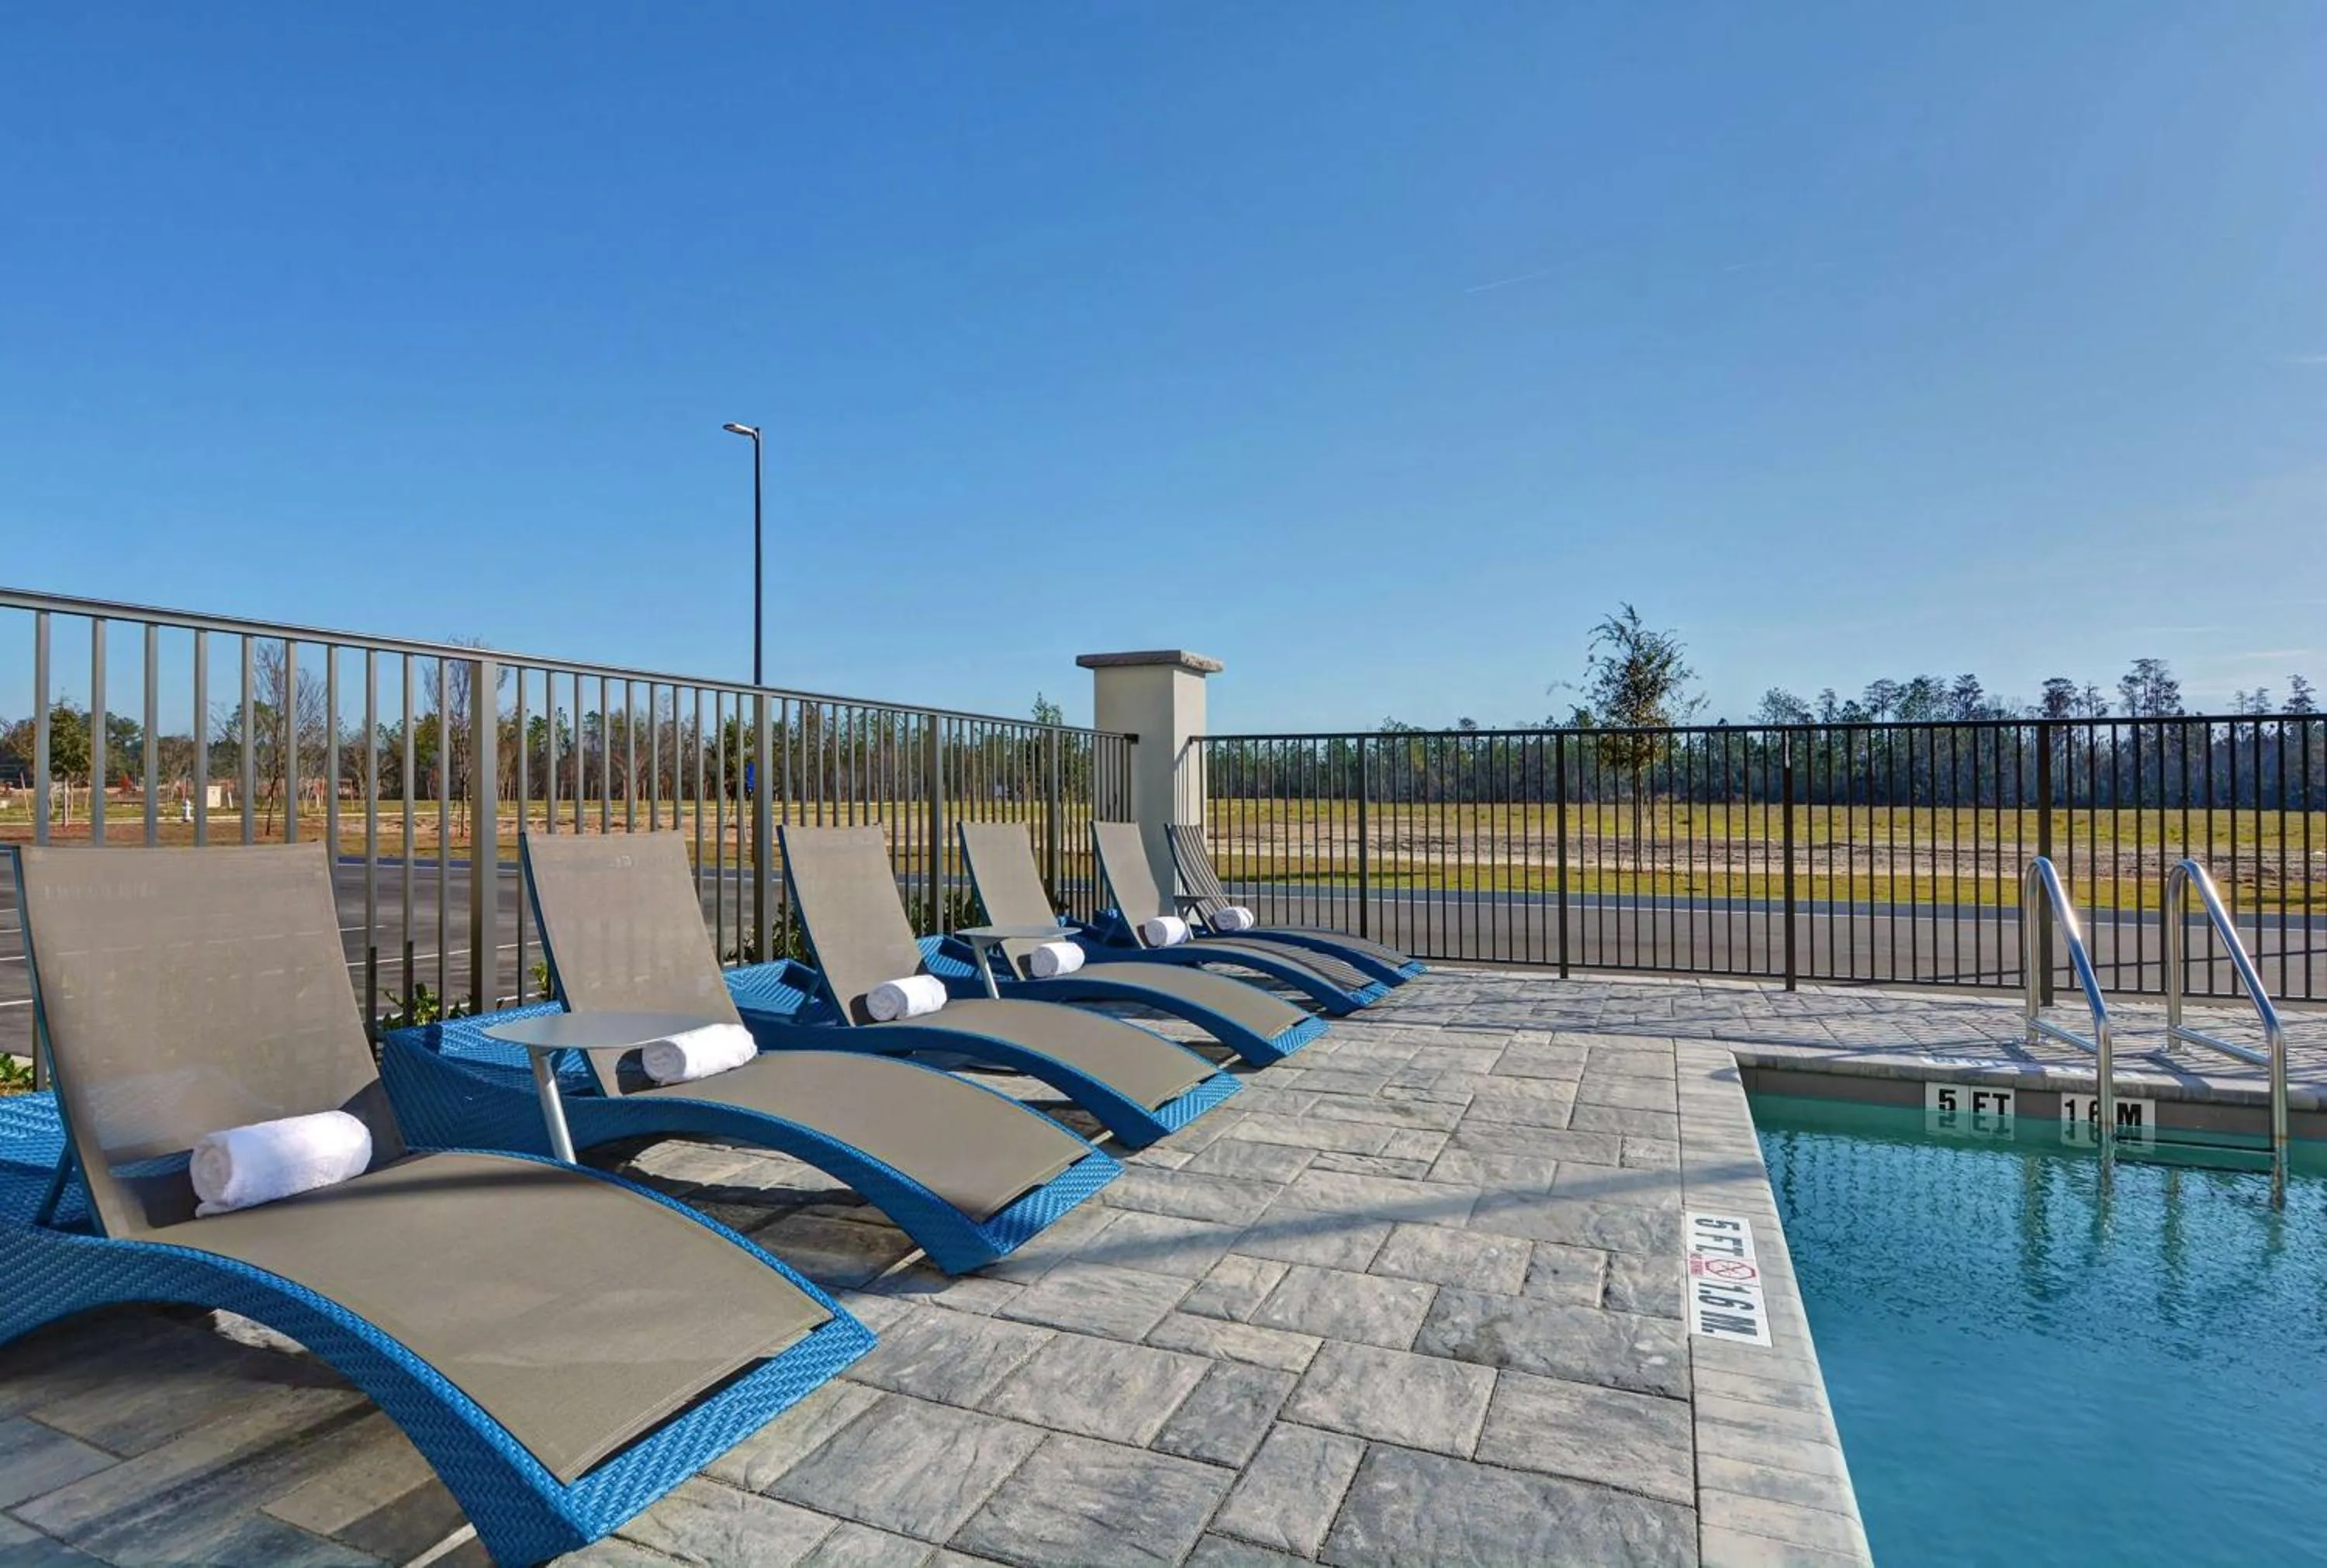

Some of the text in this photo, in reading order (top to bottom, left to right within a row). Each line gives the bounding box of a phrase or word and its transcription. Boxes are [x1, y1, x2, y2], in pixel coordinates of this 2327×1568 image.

[1938, 1088, 1956, 1111] 5
[1695, 1218, 1741, 1231] 5
[1698, 1282, 1755, 1311] 1.6
